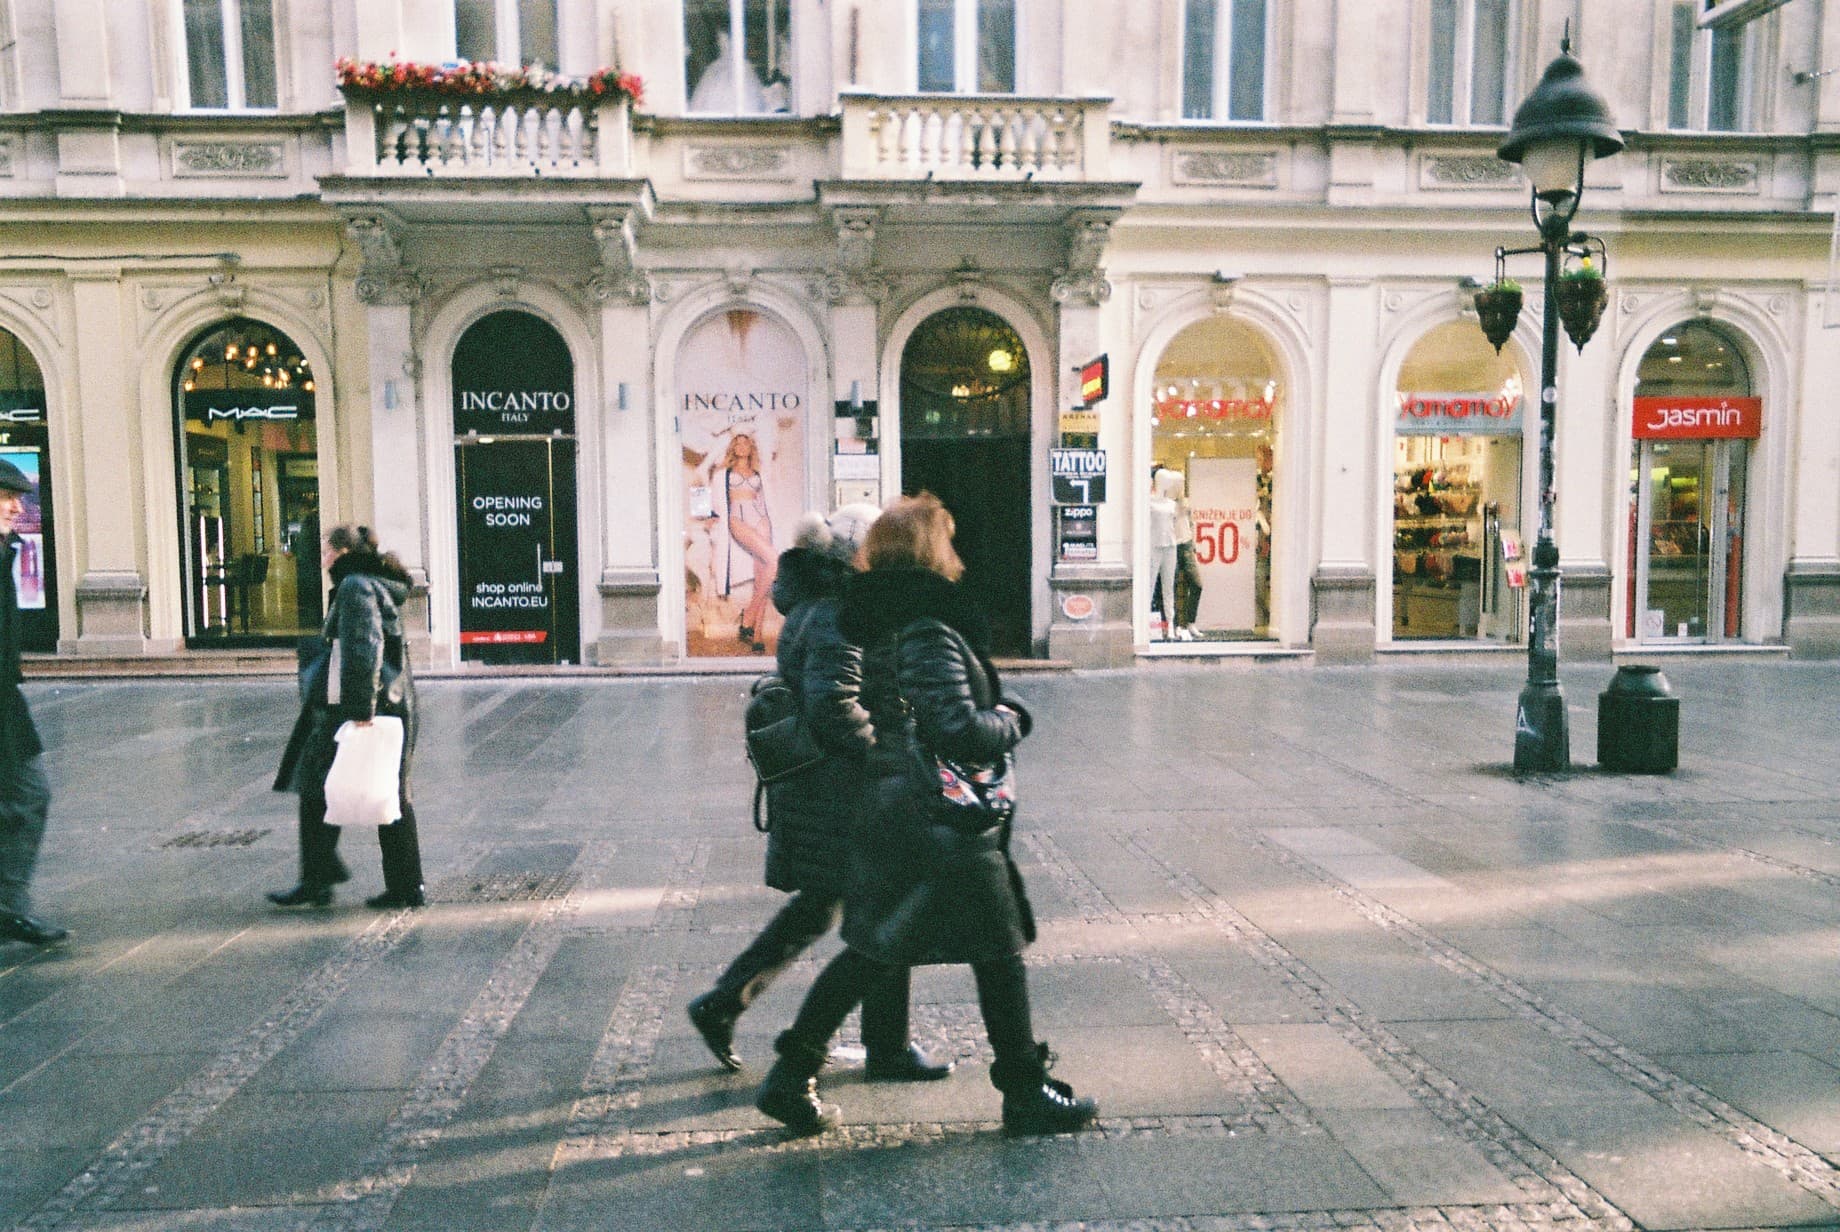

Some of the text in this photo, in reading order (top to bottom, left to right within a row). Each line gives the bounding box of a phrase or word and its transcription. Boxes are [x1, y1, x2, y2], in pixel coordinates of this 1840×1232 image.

[461, 391, 570, 411] INCANTO
[684, 392, 801, 411] INCANTO
[1398, 393, 1520, 421] yamamay
[501, 412, 530, 422] ITALY
[1647, 401, 1741, 429] Jasmin
[1053, 451, 1105, 472] TATTOO
[473, 497, 543, 509] OPENING
[486, 513, 530, 526] SOON
[1064, 507, 1094, 519] zippo
[476, 581, 505, 594] shop
[471, 596, 549, 608] INCANTO.EU
